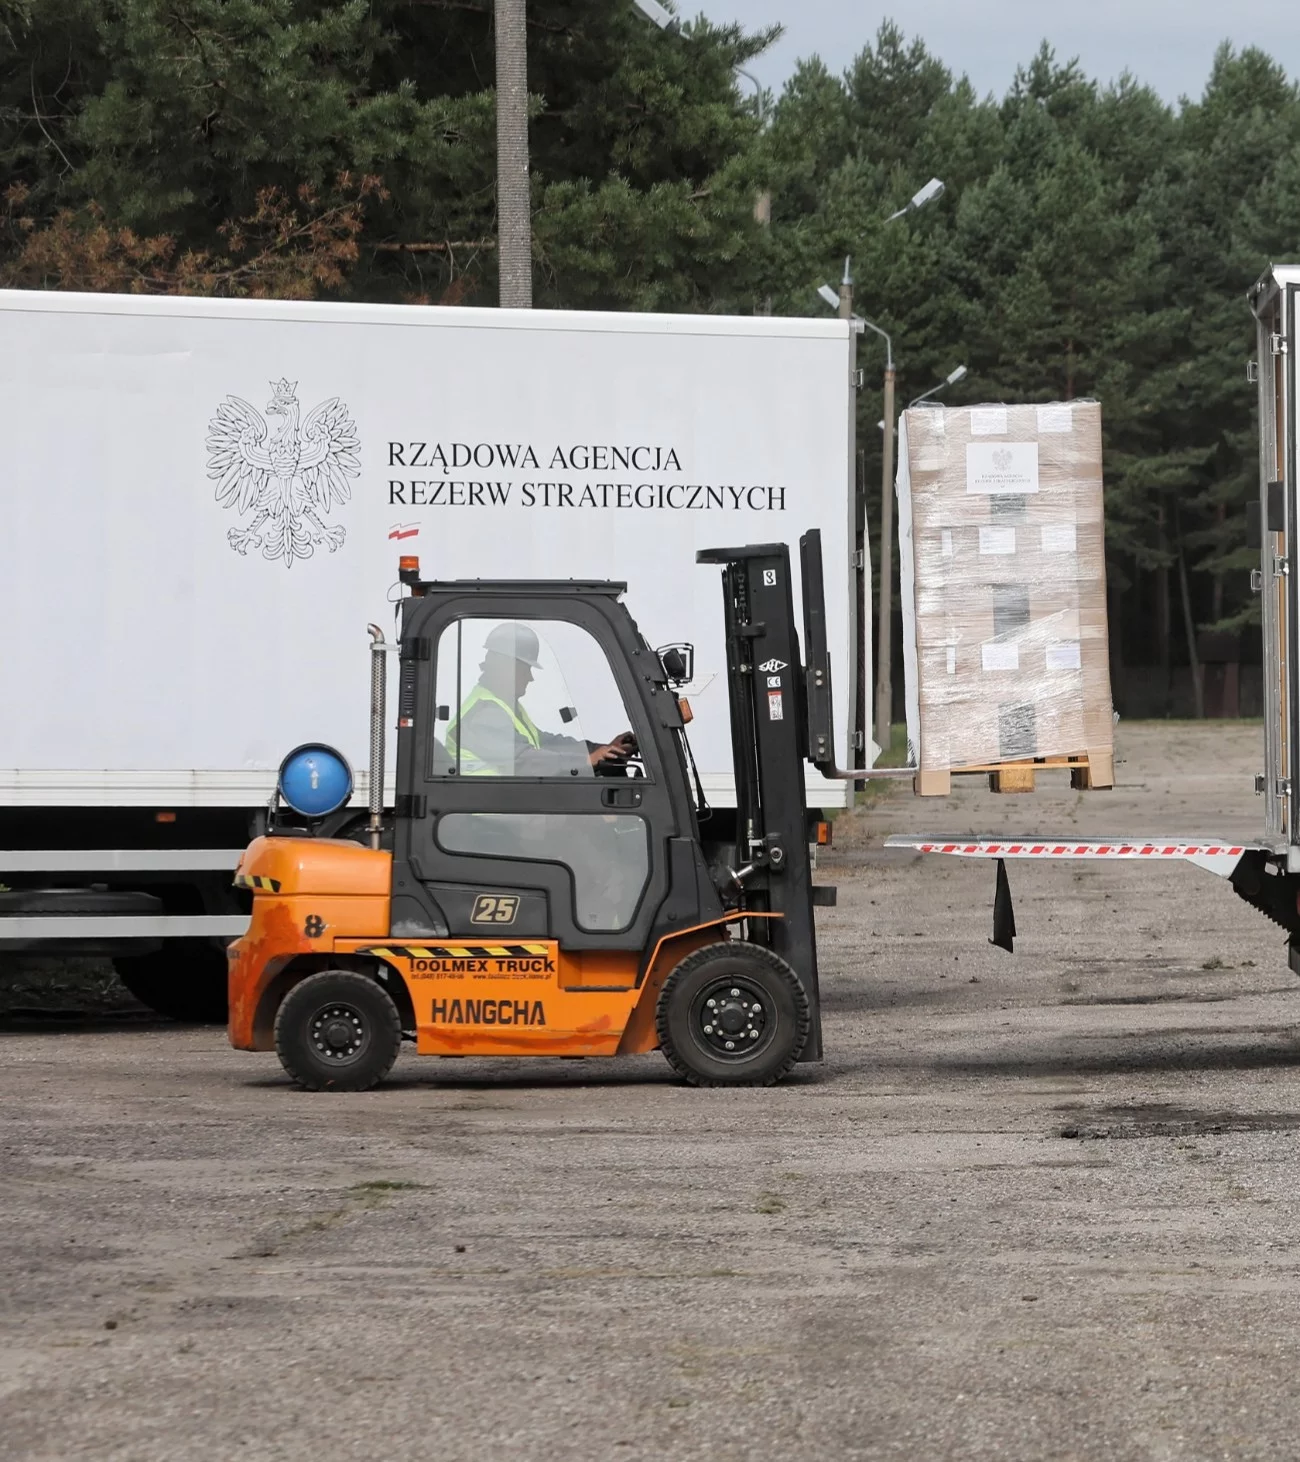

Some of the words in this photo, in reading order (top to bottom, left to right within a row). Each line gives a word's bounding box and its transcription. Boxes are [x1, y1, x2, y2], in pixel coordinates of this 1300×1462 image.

[388, 442, 541, 475] RZĄDOWA
[548, 445, 683, 471] AGENCJA
[388, 480, 513, 506] REZERW
[521, 483, 786, 510] STRATEGICZNYCH
[476, 898, 515, 921] 25
[410, 957, 488, 972] TOOLMEX
[496, 959, 555, 972] TRUCK
[431, 999, 546, 1025] HANGCHA
